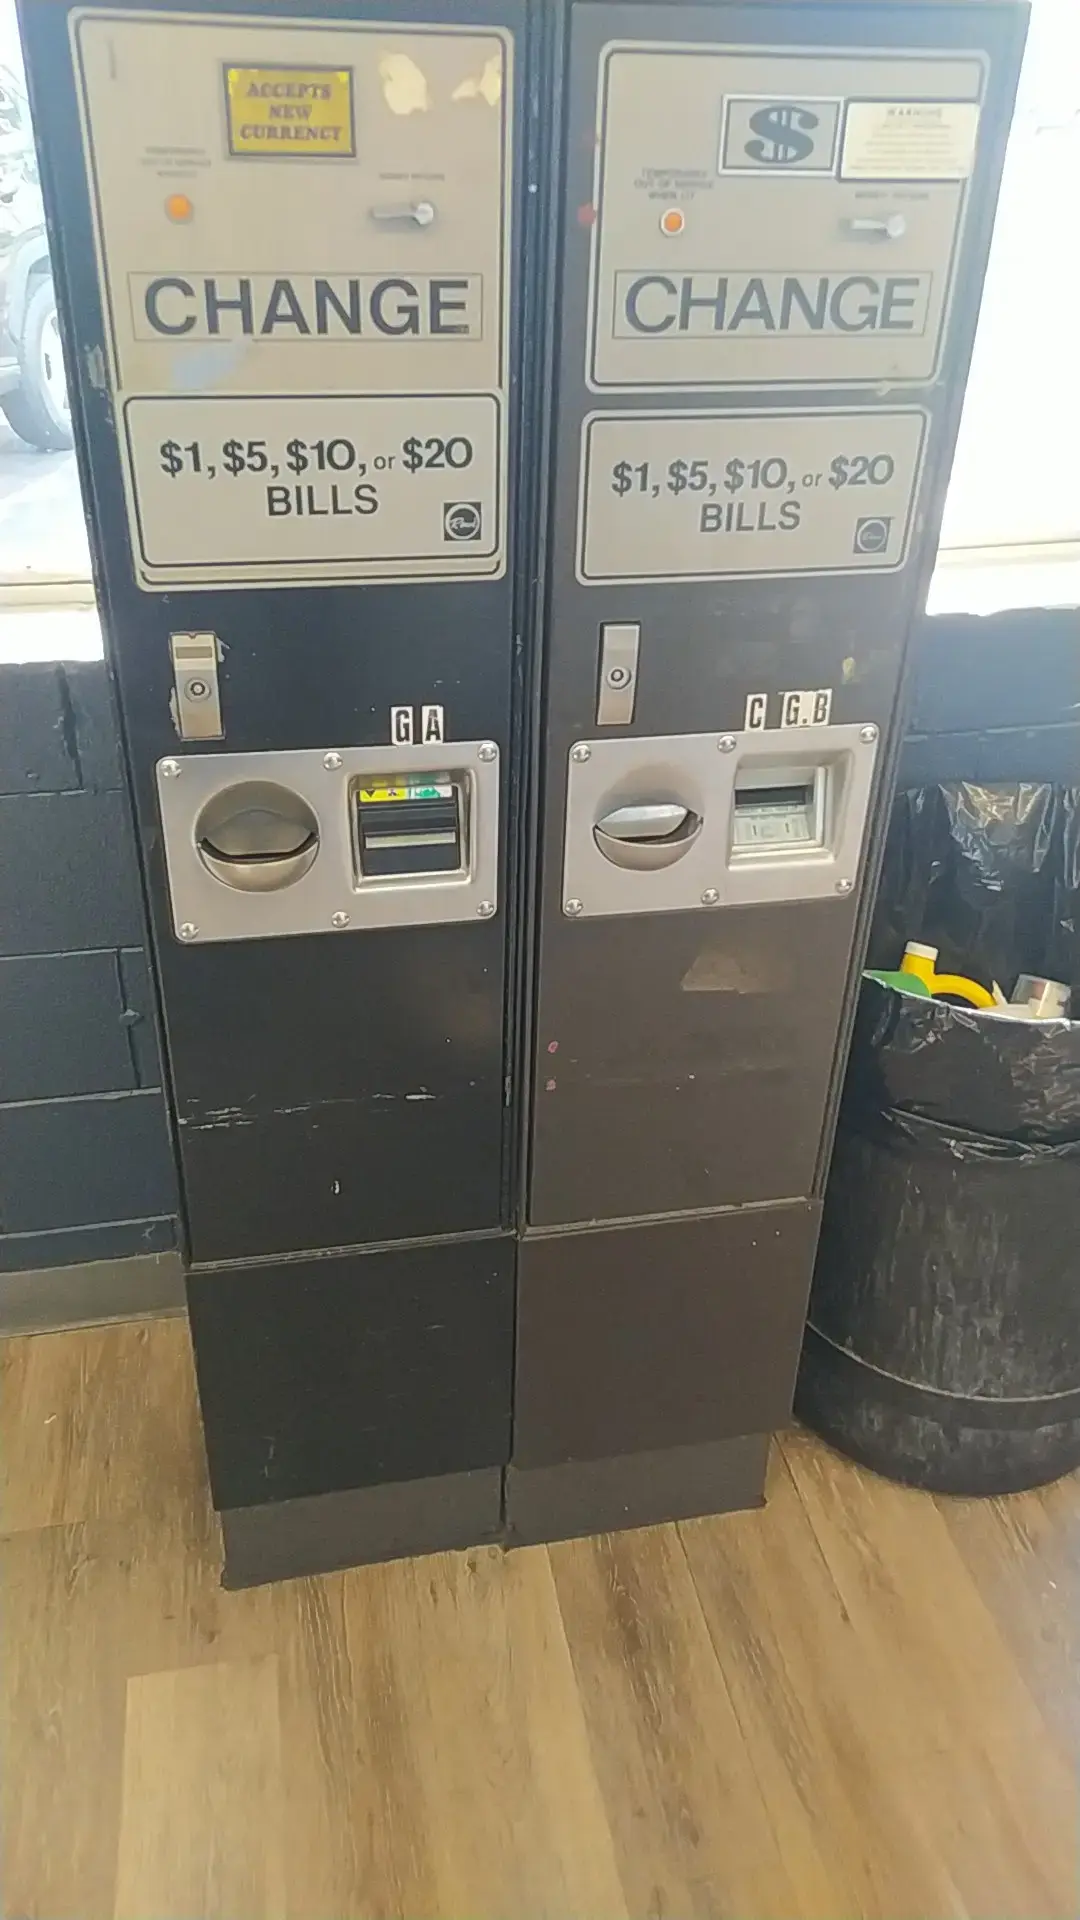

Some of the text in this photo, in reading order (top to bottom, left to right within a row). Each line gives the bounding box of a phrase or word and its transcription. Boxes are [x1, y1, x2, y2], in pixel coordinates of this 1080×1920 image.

[246, 82, 332, 100] ACCEPTS
[268, 104, 313, 121] NEW
[239, 124, 343, 141] CURRENCY
[144, 277, 470, 336] CHANGE
[625, 275, 920, 334] CHANGE
[159, 436, 474, 480] $1, $5, $10, or $20
[611, 453, 895, 499] $1, $5, $10, or $20
[266, 483, 380, 517] BILLS
[699, 499, 801, 533] BILLS
[395, 708, 442, 742] G A
[749, 697, 764, 729] C
